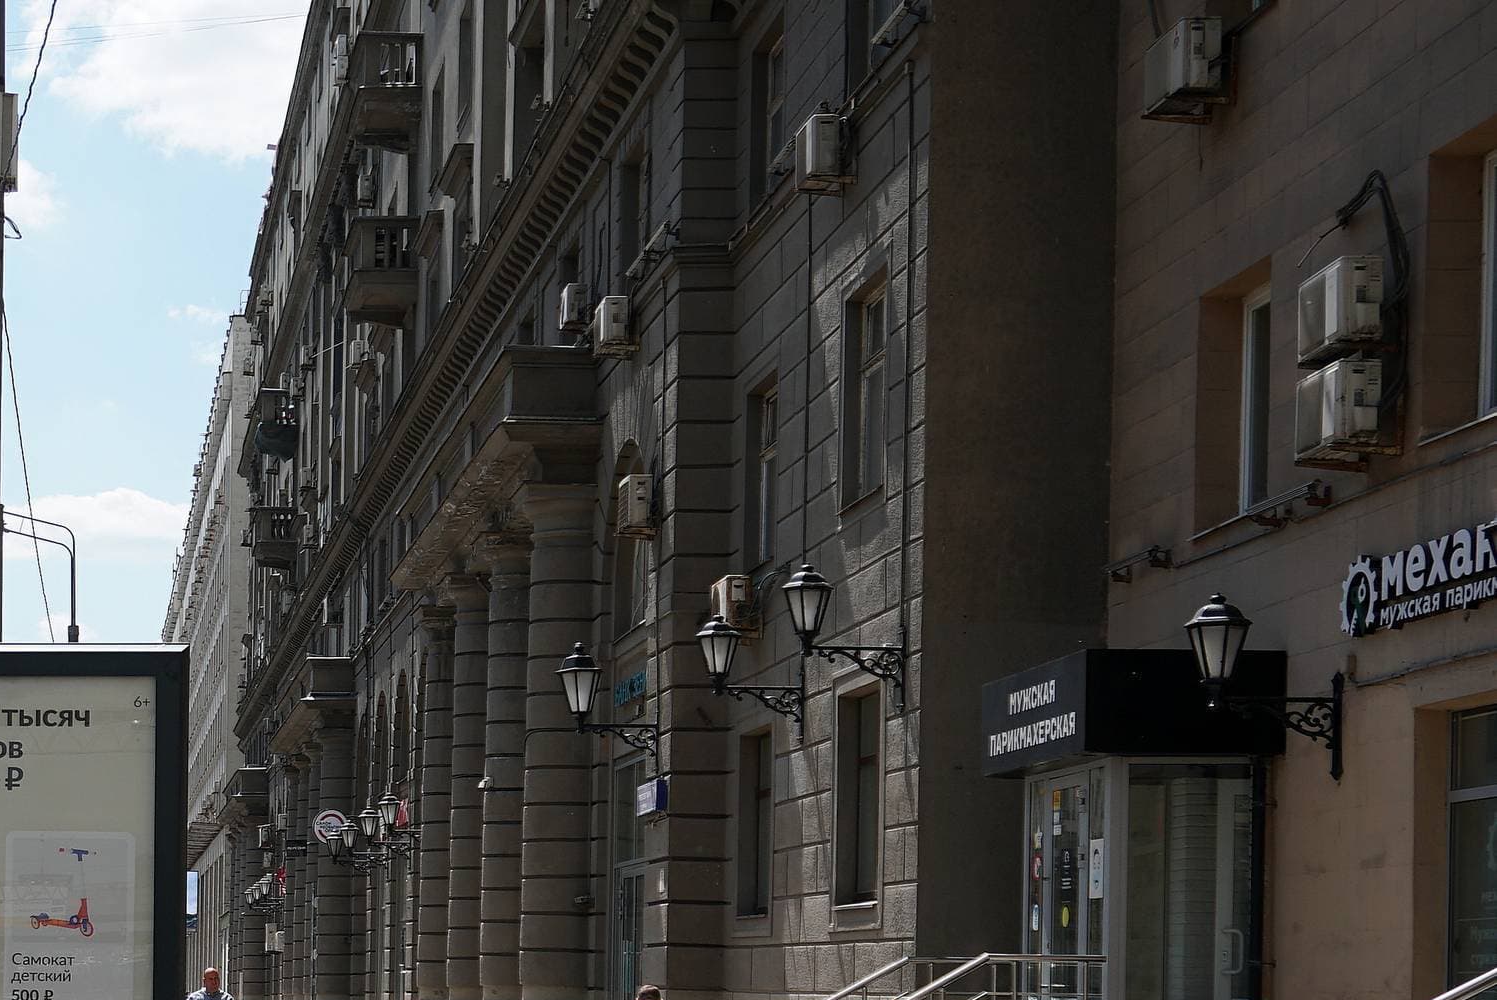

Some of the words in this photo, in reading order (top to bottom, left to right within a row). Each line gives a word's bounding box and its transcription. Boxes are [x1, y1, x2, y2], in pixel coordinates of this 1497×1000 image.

[1379, 592, 1441, 630] мужская
[133, 695, 151, 708] 6+
[1009, 679, 1056, 715] МУЖСКАЯ
[1, 708, 91, 727] тысяч
[989, 711, 1076, 757] ПАРИКМАХЕРСКАЯ
[11, 952, 75, 966] Самокат
[11, 968, 72, 983] детский
